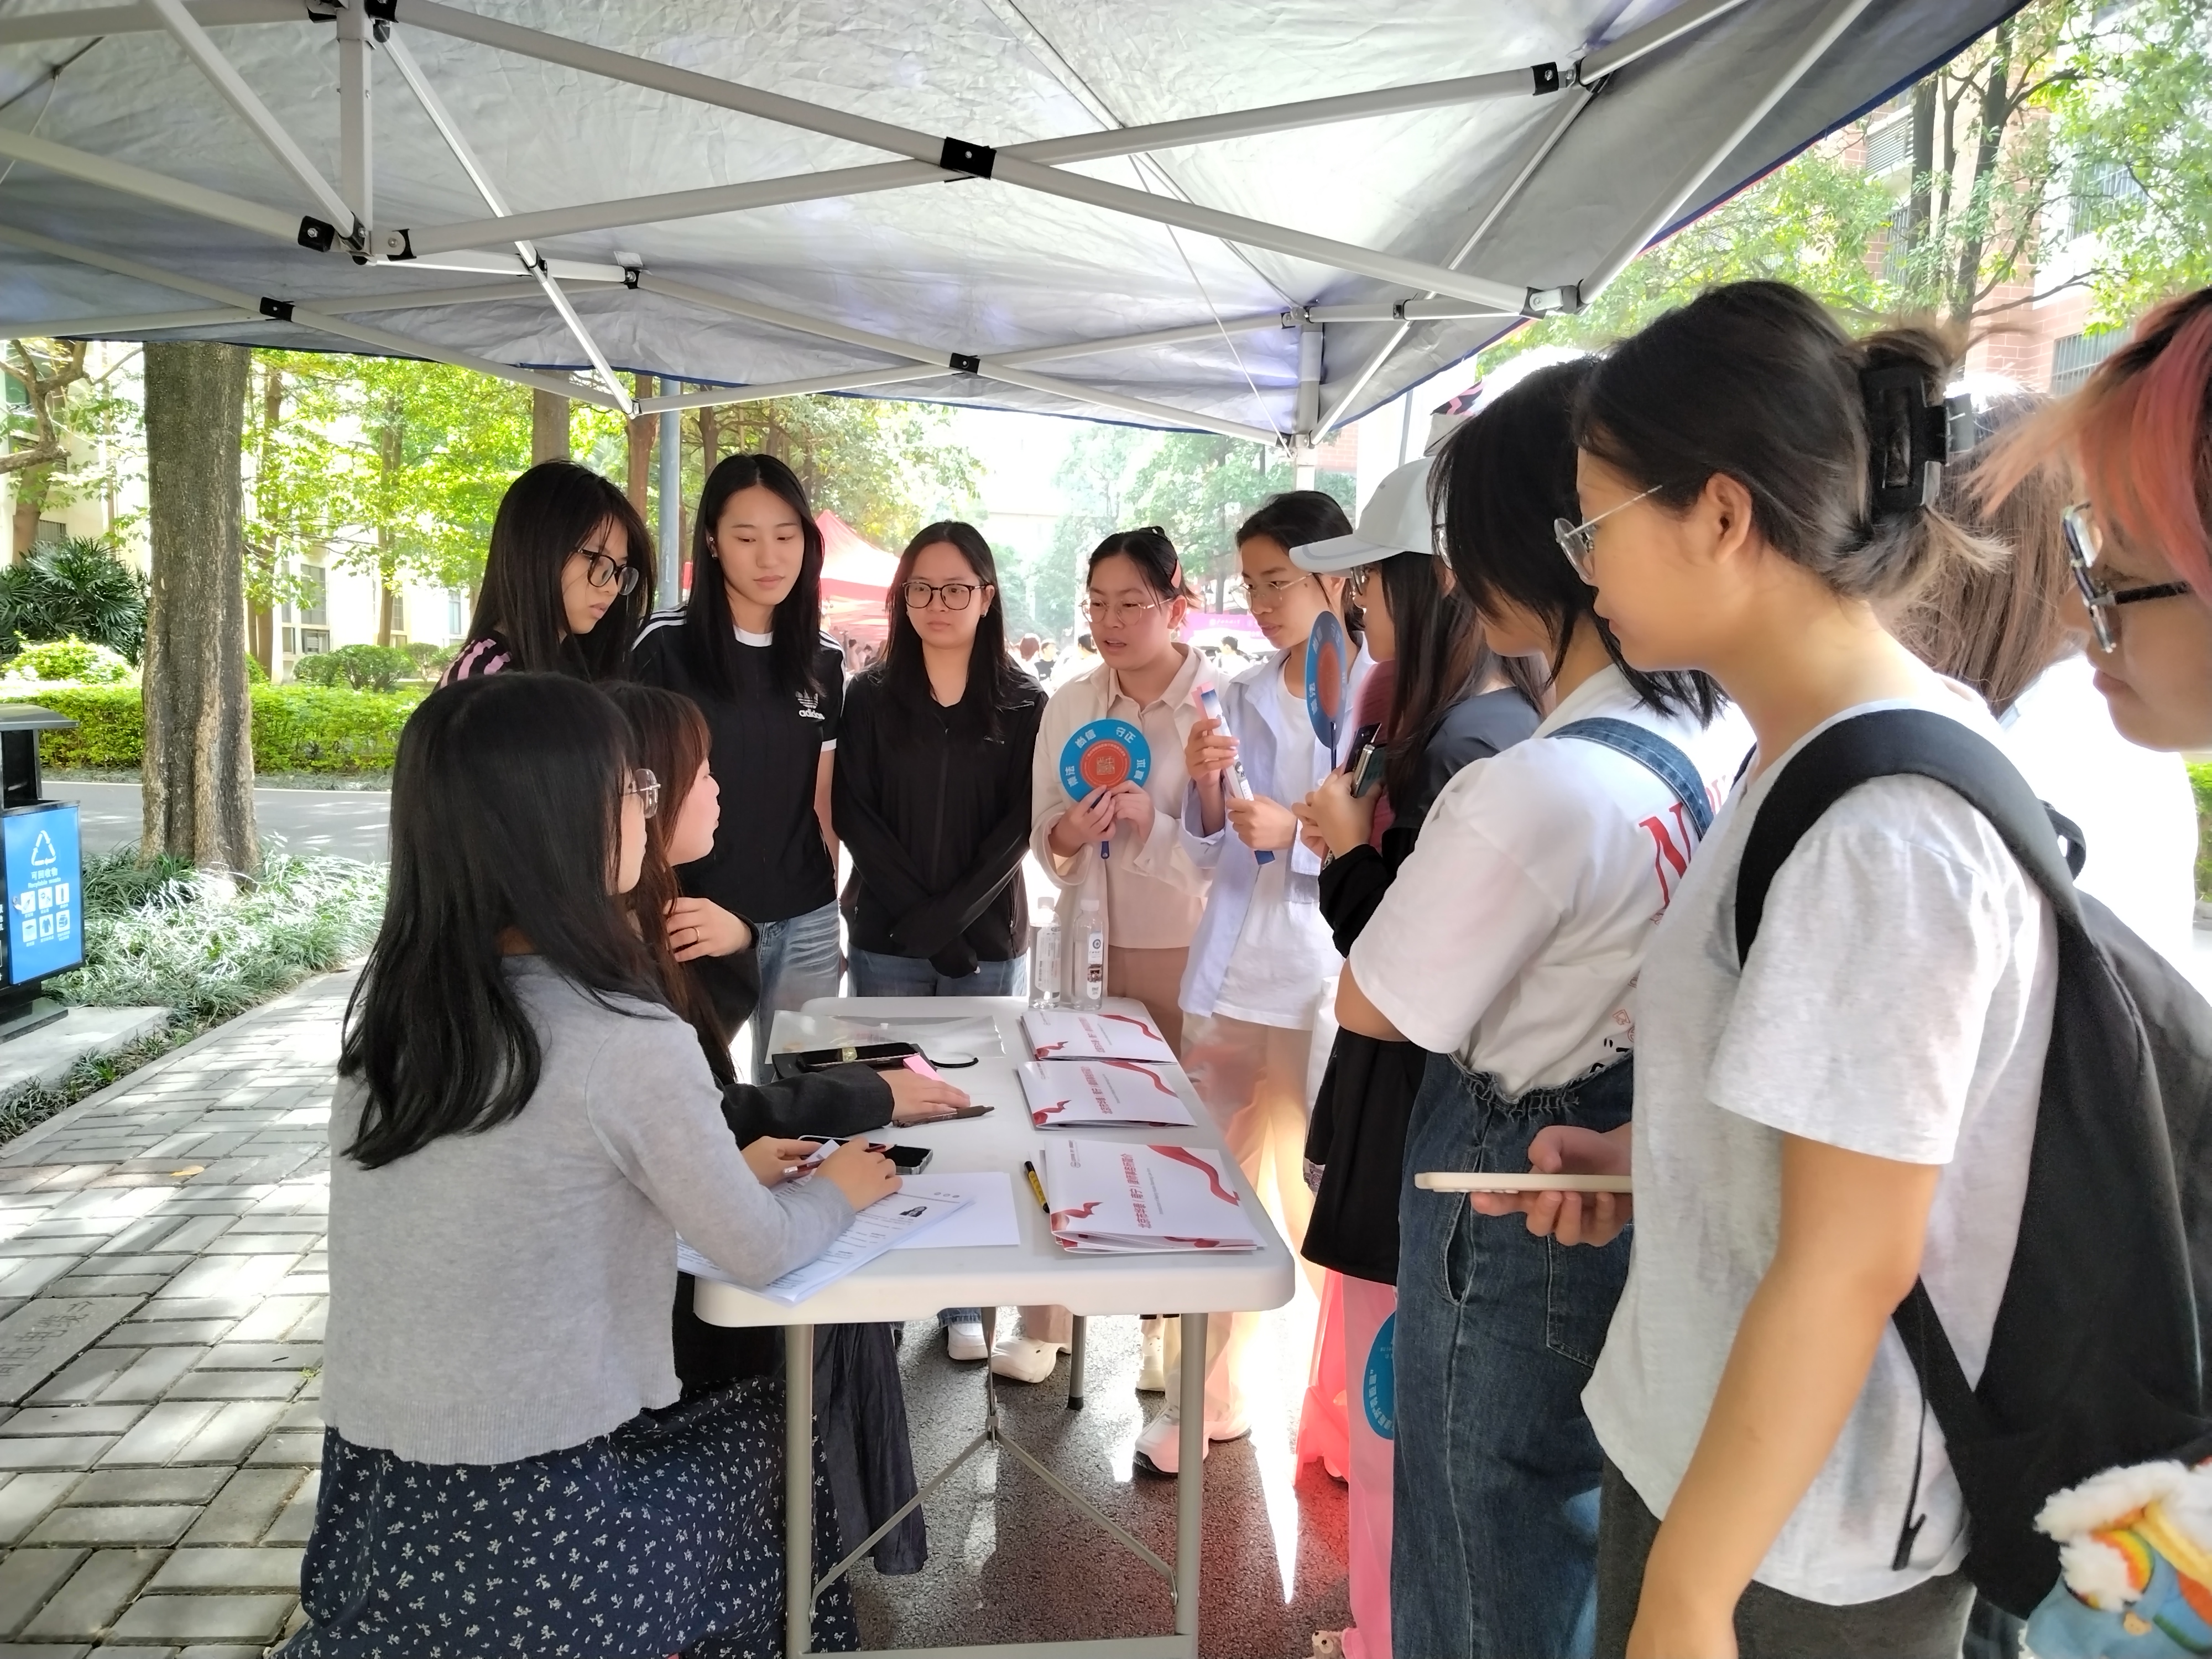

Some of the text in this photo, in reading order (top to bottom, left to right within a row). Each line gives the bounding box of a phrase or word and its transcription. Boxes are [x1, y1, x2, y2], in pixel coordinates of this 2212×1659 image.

[799, 708, 825, 719] adidas
[1116, 727, 1136, 743] 守正
[30, 867, 58, 880] 可回收物
